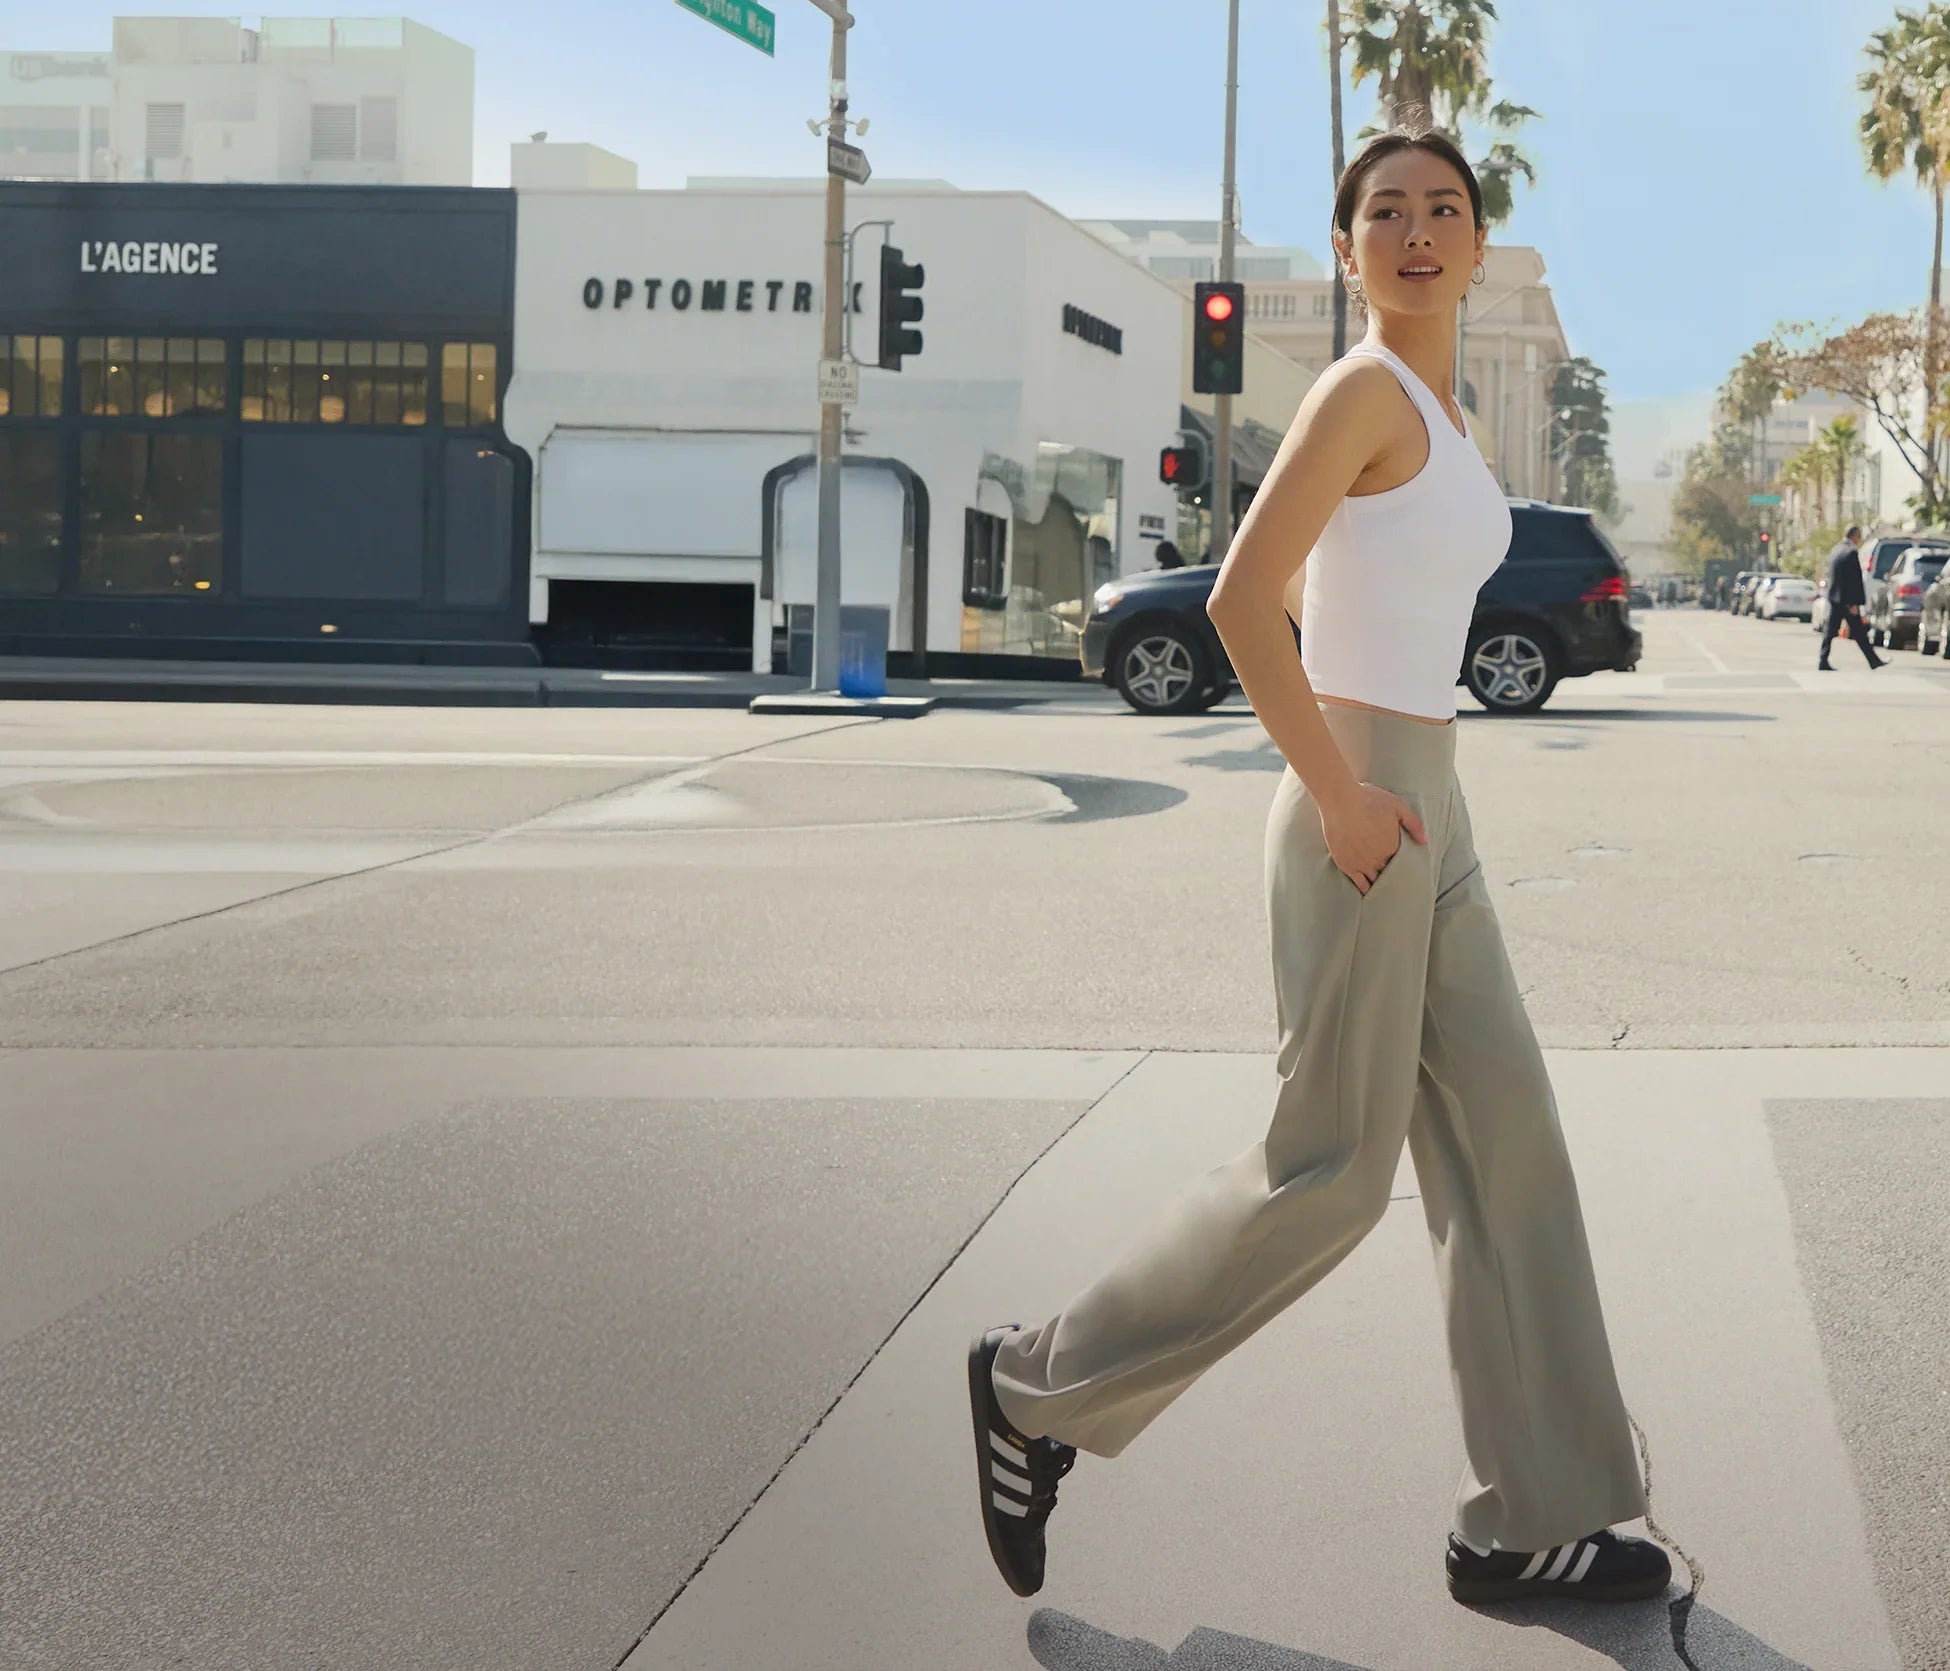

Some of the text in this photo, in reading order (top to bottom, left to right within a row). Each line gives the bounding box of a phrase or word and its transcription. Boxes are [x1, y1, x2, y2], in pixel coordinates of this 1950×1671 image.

[747, 9, 771, 48] Way
[81, 241, 218, 275] L'AGENCE
[582, 277, 863, 313] OPTOMETRX
[831, 366, 847, 378] NO
